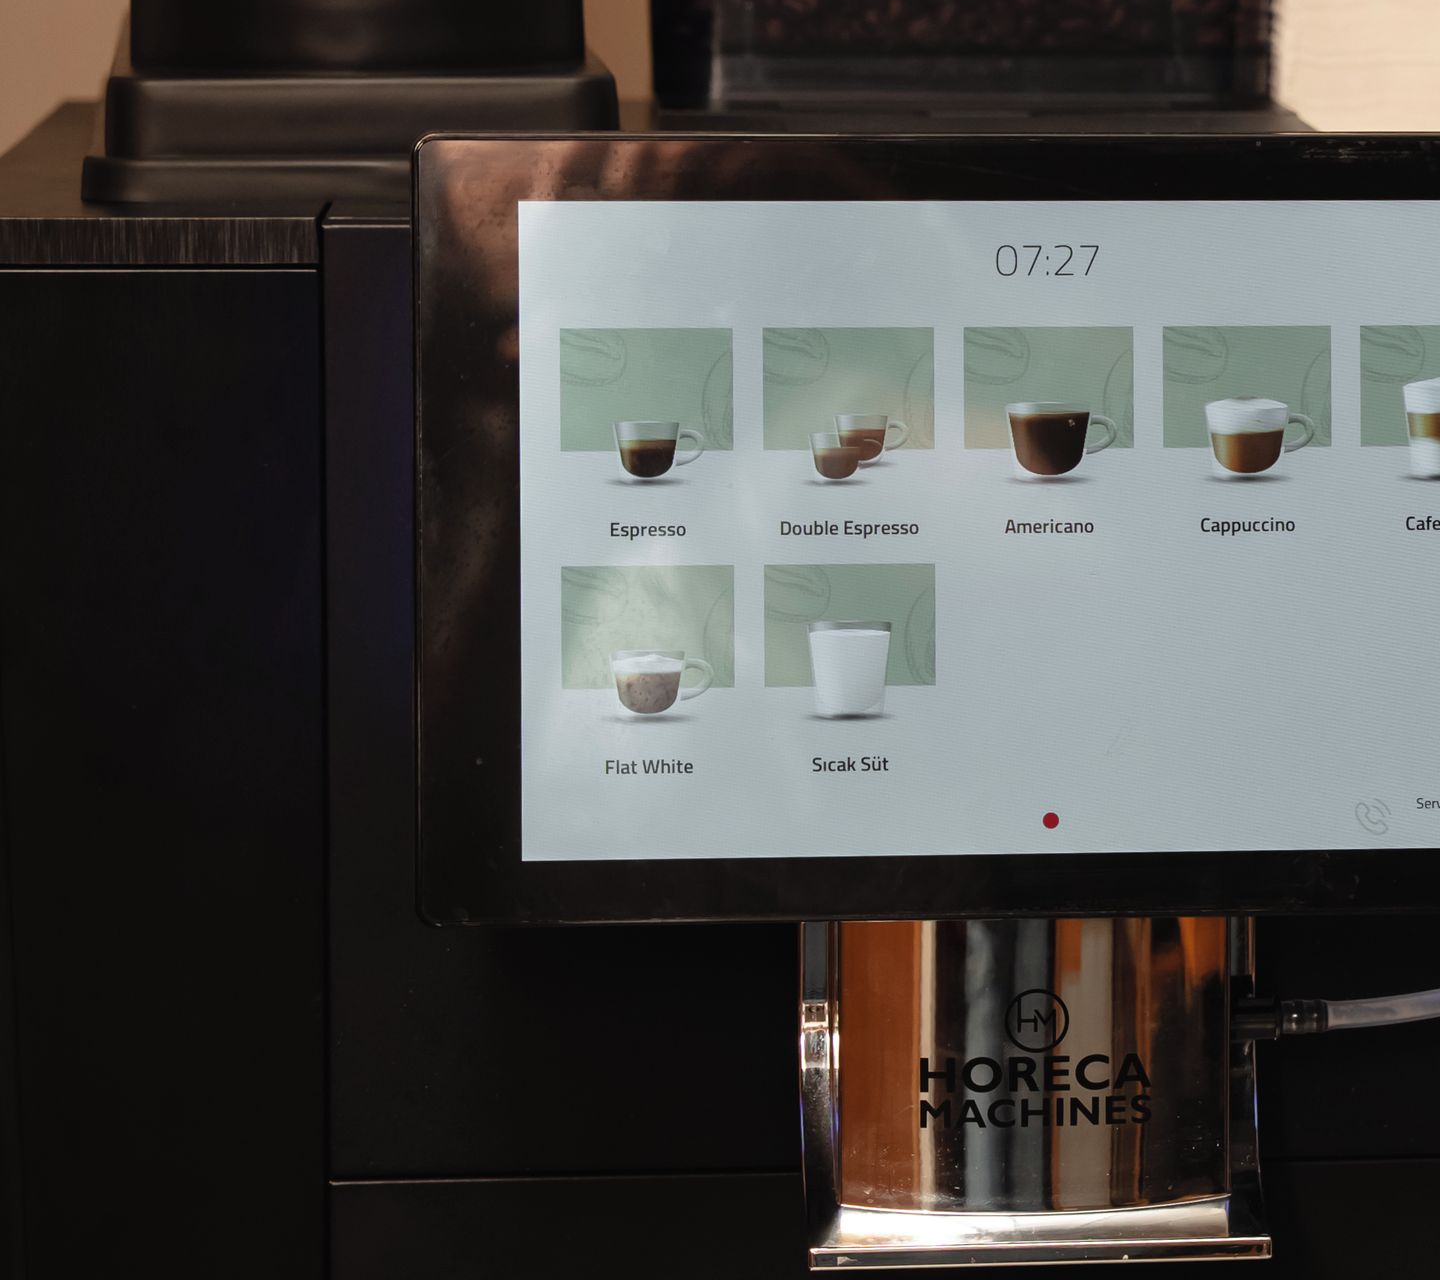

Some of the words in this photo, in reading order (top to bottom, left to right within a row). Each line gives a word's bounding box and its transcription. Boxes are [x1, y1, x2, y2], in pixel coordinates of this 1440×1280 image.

[995, 244, 1100, 277] 07:27
[610, 522, 687, 541] Espresso
[780, 520, 840, 536] Double
[843, 520, 920, 539] Espresso
[1004, 518, 1095, 534] Americano
[1200, 516, 1296, 537] Cappuccino
[605, 759, 637, 775] Flat
[640, 759, 694, 775] White
[812, 756, 857, 773] Sıcak
[860, 754, 889, 772] Süt
[920, 1053, 1152, 1093] HORECA
[920, 1094, 1152, 1129] MACHINES
